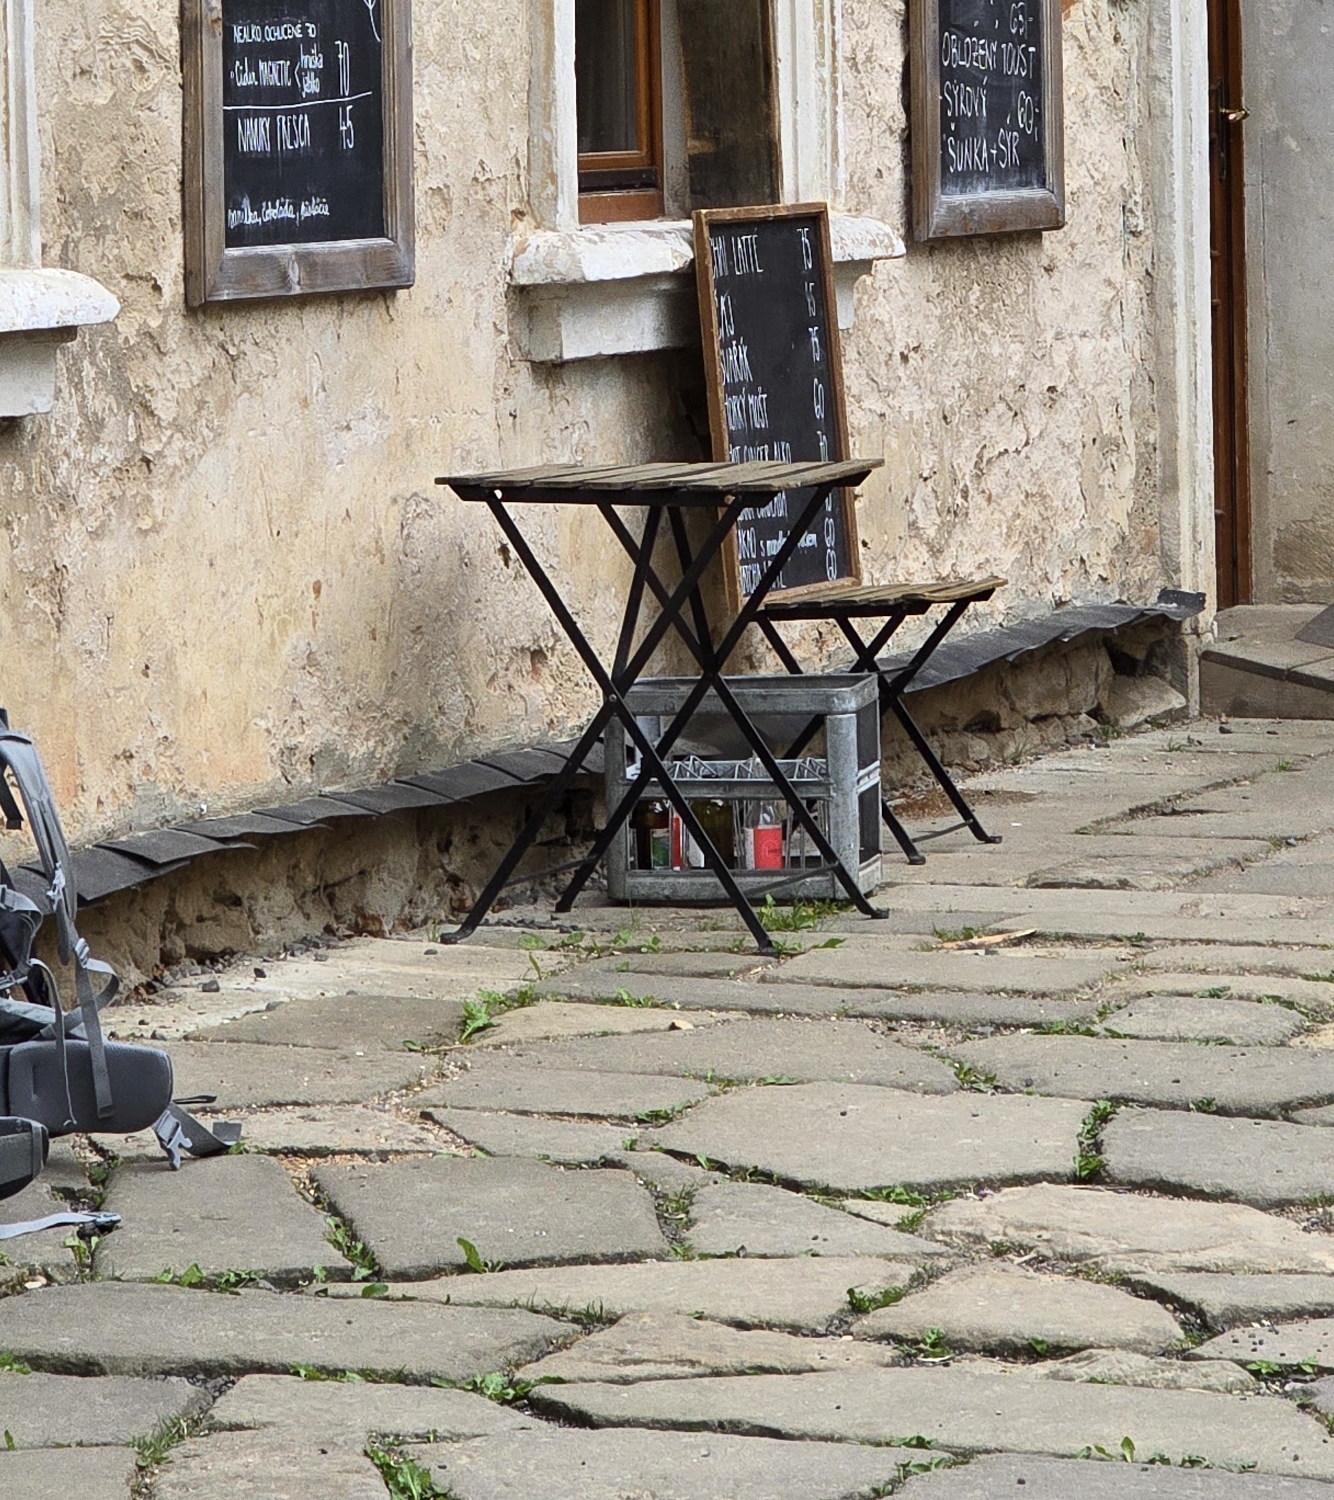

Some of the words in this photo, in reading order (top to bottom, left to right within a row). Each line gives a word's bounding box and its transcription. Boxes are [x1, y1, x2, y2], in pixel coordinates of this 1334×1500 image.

[335, 41, 349, 96] 70
[1001, 43, 1037, 80] TOUST
[276, 114, 311, 152] FRESCA
[339, 106, 355, 150] 45
[796, 227, 813, 271] 75
[808, 326, 820, 363] 75
[813, 377, 825, 420] 60
